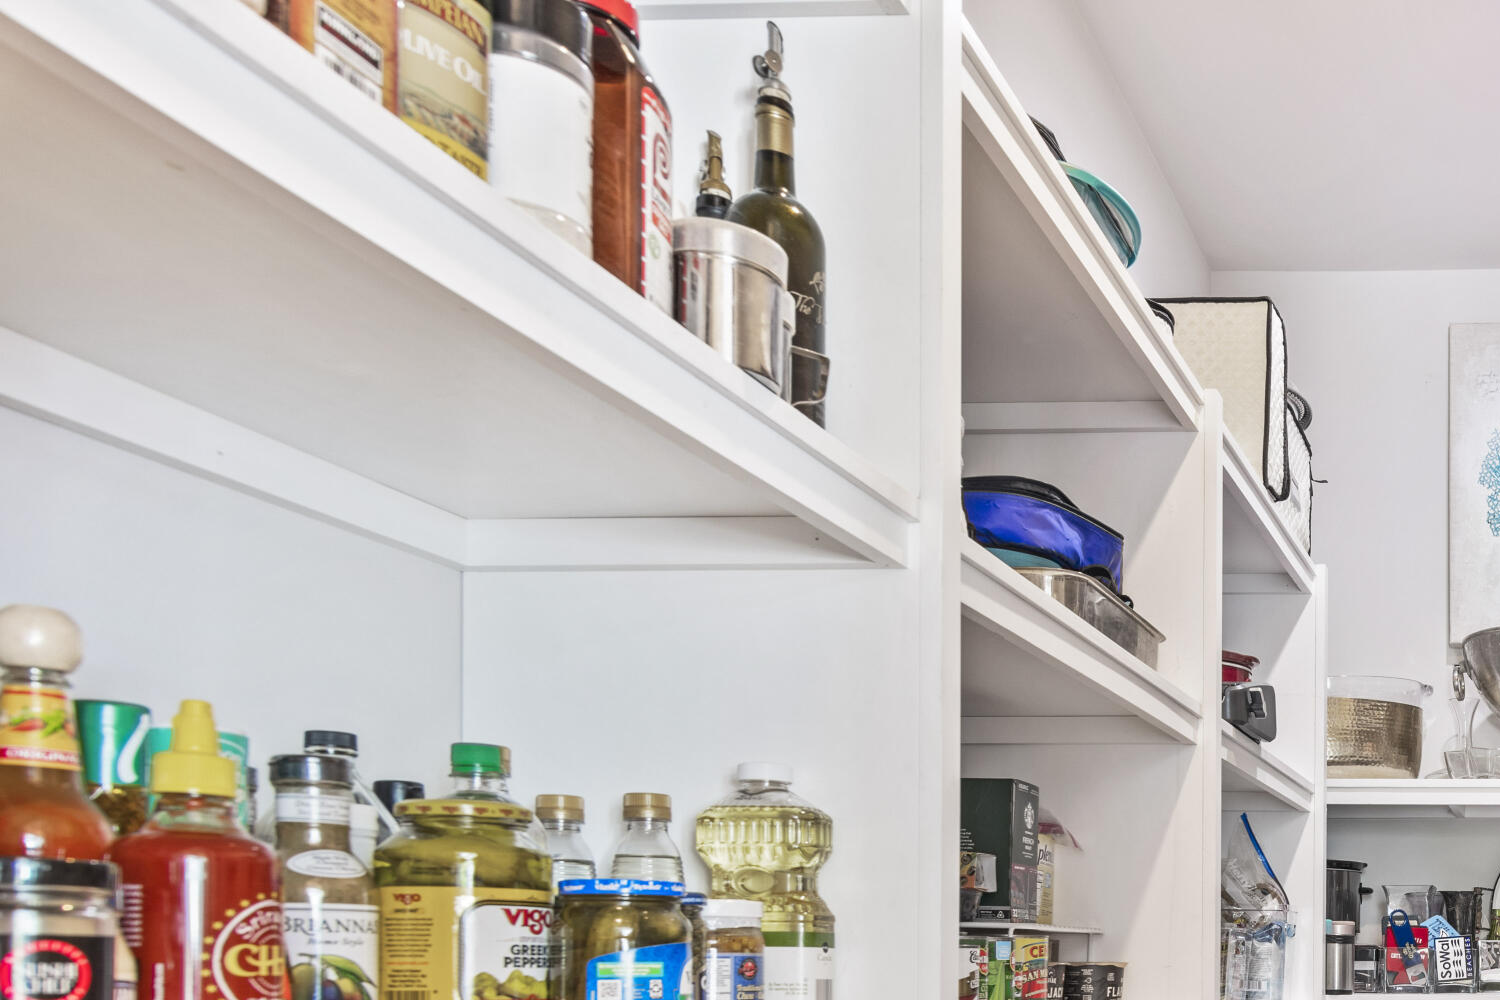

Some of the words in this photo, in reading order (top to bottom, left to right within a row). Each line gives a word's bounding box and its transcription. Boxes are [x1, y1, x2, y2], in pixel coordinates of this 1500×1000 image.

[402, 28, 452, 71] LIVE
[1438, 939, 1452, 979] SoWal
[1464, 936, 1473, 977] BEACHES
